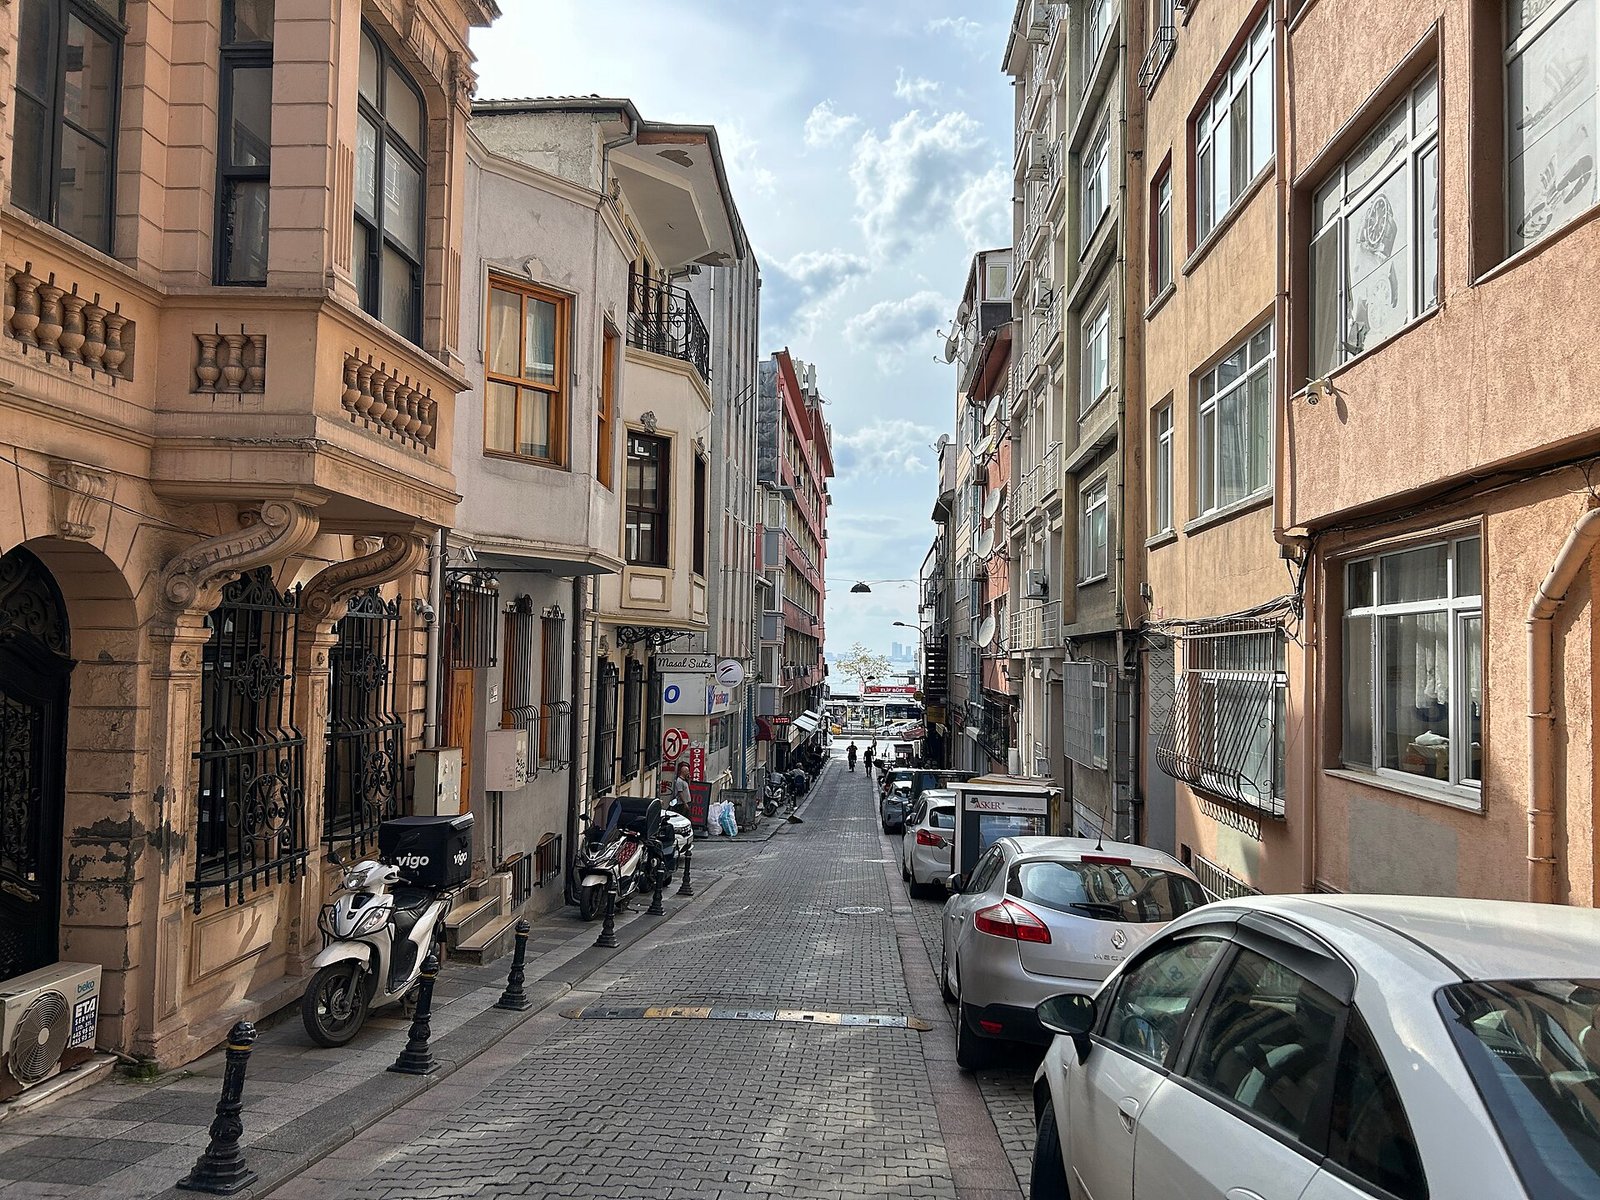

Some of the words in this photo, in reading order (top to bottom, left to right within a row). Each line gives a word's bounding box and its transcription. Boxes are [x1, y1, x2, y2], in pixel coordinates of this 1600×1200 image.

[657, 657, 687, 668] Masal
[688, 658, 713, 669] Suite
[693, 748, 701, 782] OTOPARK
[974, 801, 1001, 810] ASKER
[396, 852, 430, 869] vigo
[453, 850, 468, 866] vigo
[78, 981, 95, 993] beko
[75, 998, 96, 1018] ETA
